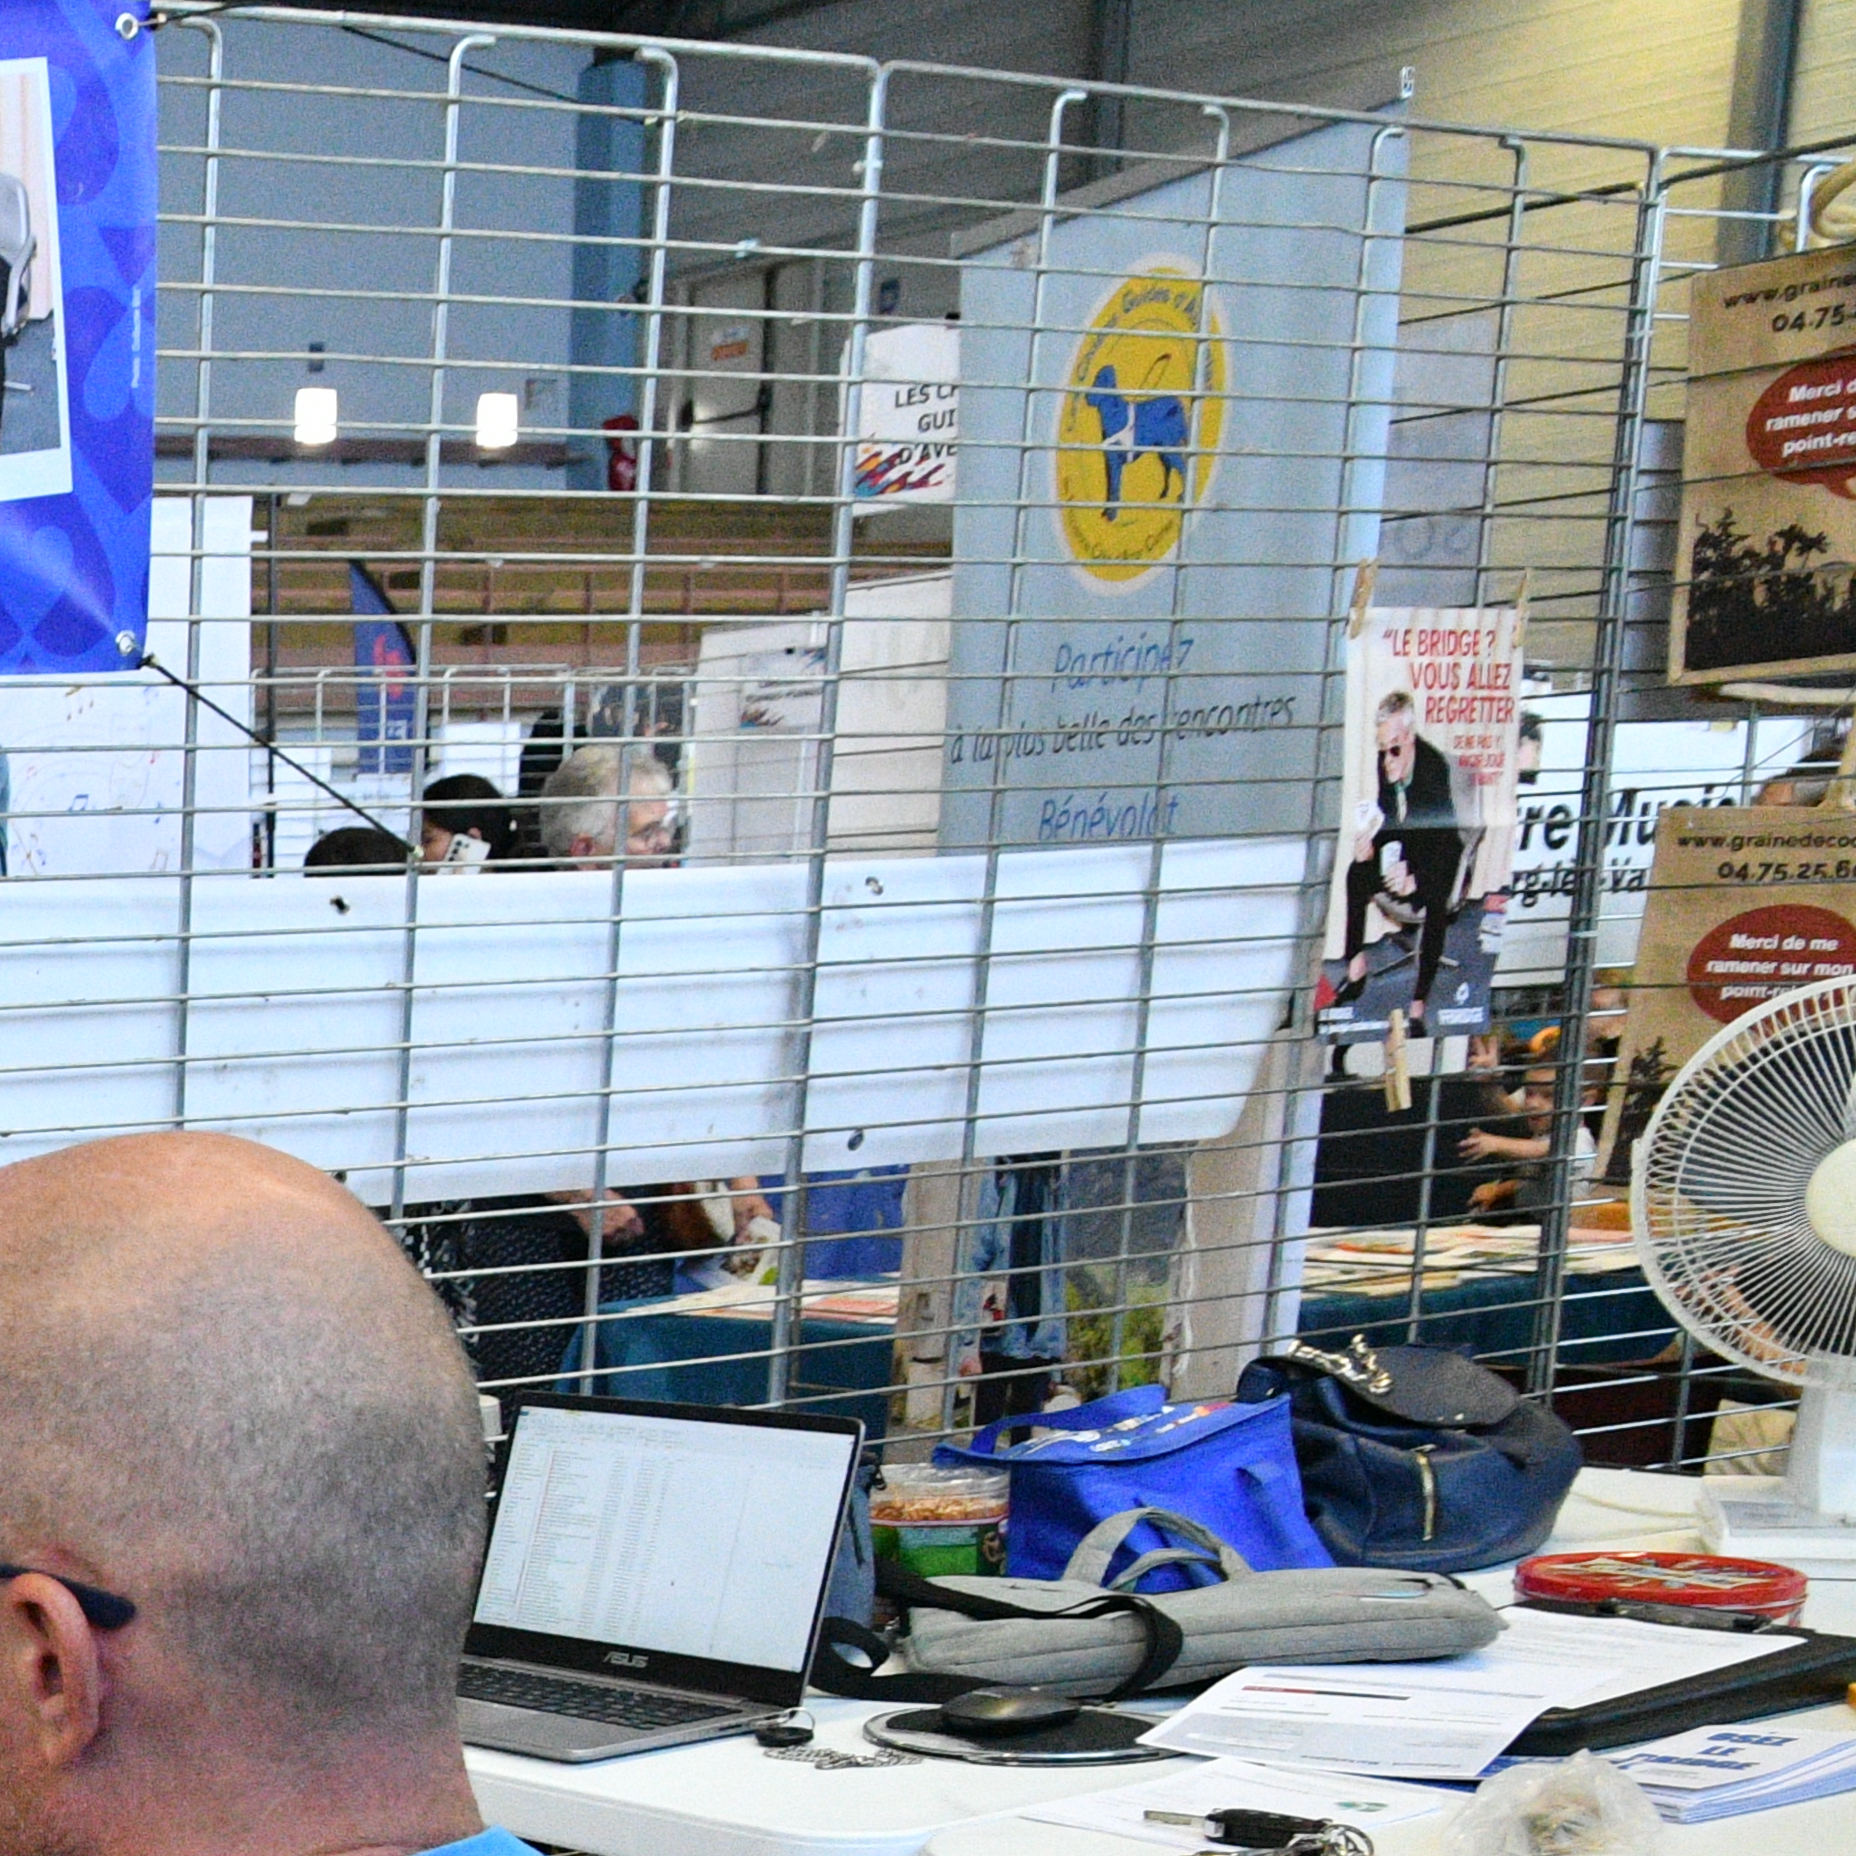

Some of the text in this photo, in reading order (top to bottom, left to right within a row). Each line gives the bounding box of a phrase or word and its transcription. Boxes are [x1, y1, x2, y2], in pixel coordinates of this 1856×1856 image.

[895, 383, 930, 408] LES
[1418, 629, 1480, 656] BRIDGE
[1411, 662, 1512, 690] VOUS ALLEZ
[1425, 695, 1515, 724] REGRETTER
[1729, 934, 1839, 951] Merci de me
[1706, 959, 1855, 977] ramener sur mon
[603, 1651, 649, 1669] ASUS
